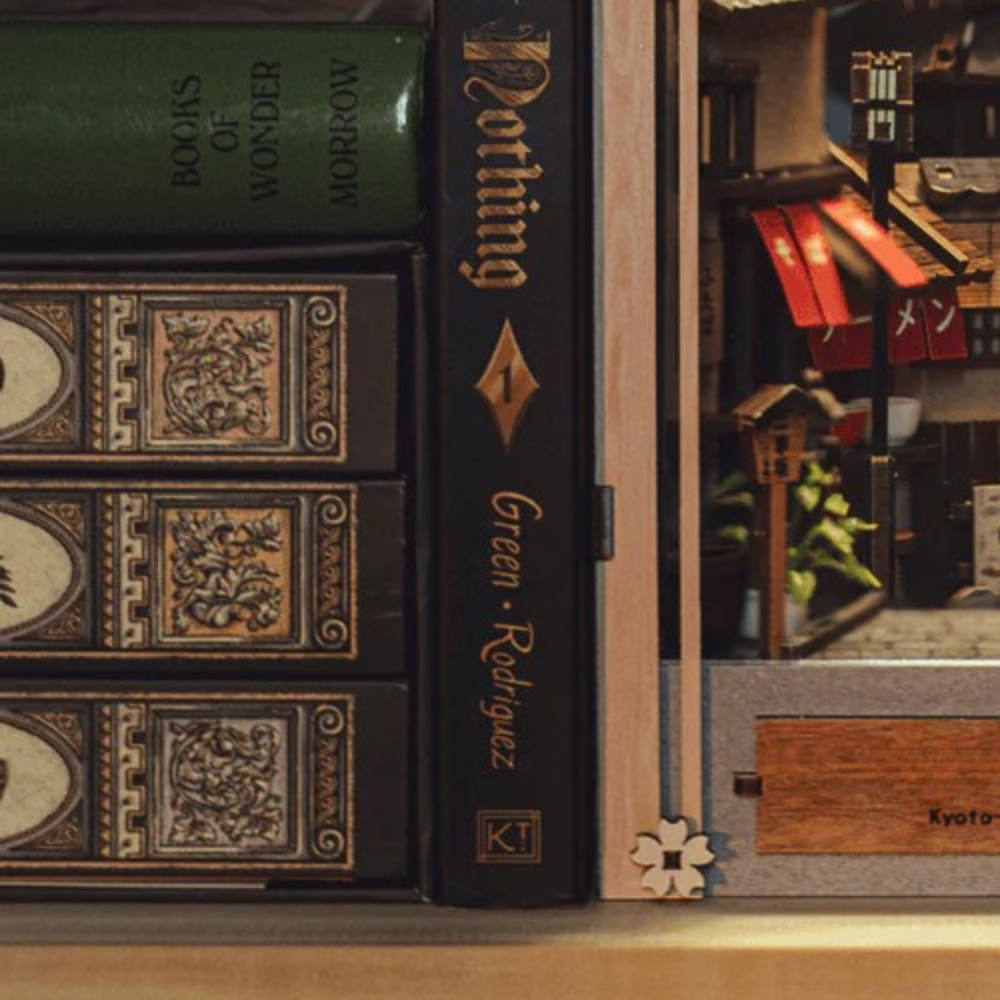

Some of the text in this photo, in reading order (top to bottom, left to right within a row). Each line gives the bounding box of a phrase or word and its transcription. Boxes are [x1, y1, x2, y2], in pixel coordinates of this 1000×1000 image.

[171, 74, 200, 188] BOOKS
[210, 110, 239, 153] OF
[249, 59, 281, 202] WONDER
[330, 58, 358, 208] MORROW
[459, 22, 550, 288] Nothing
[480, 490, 543, 770] Green Rodriguez
